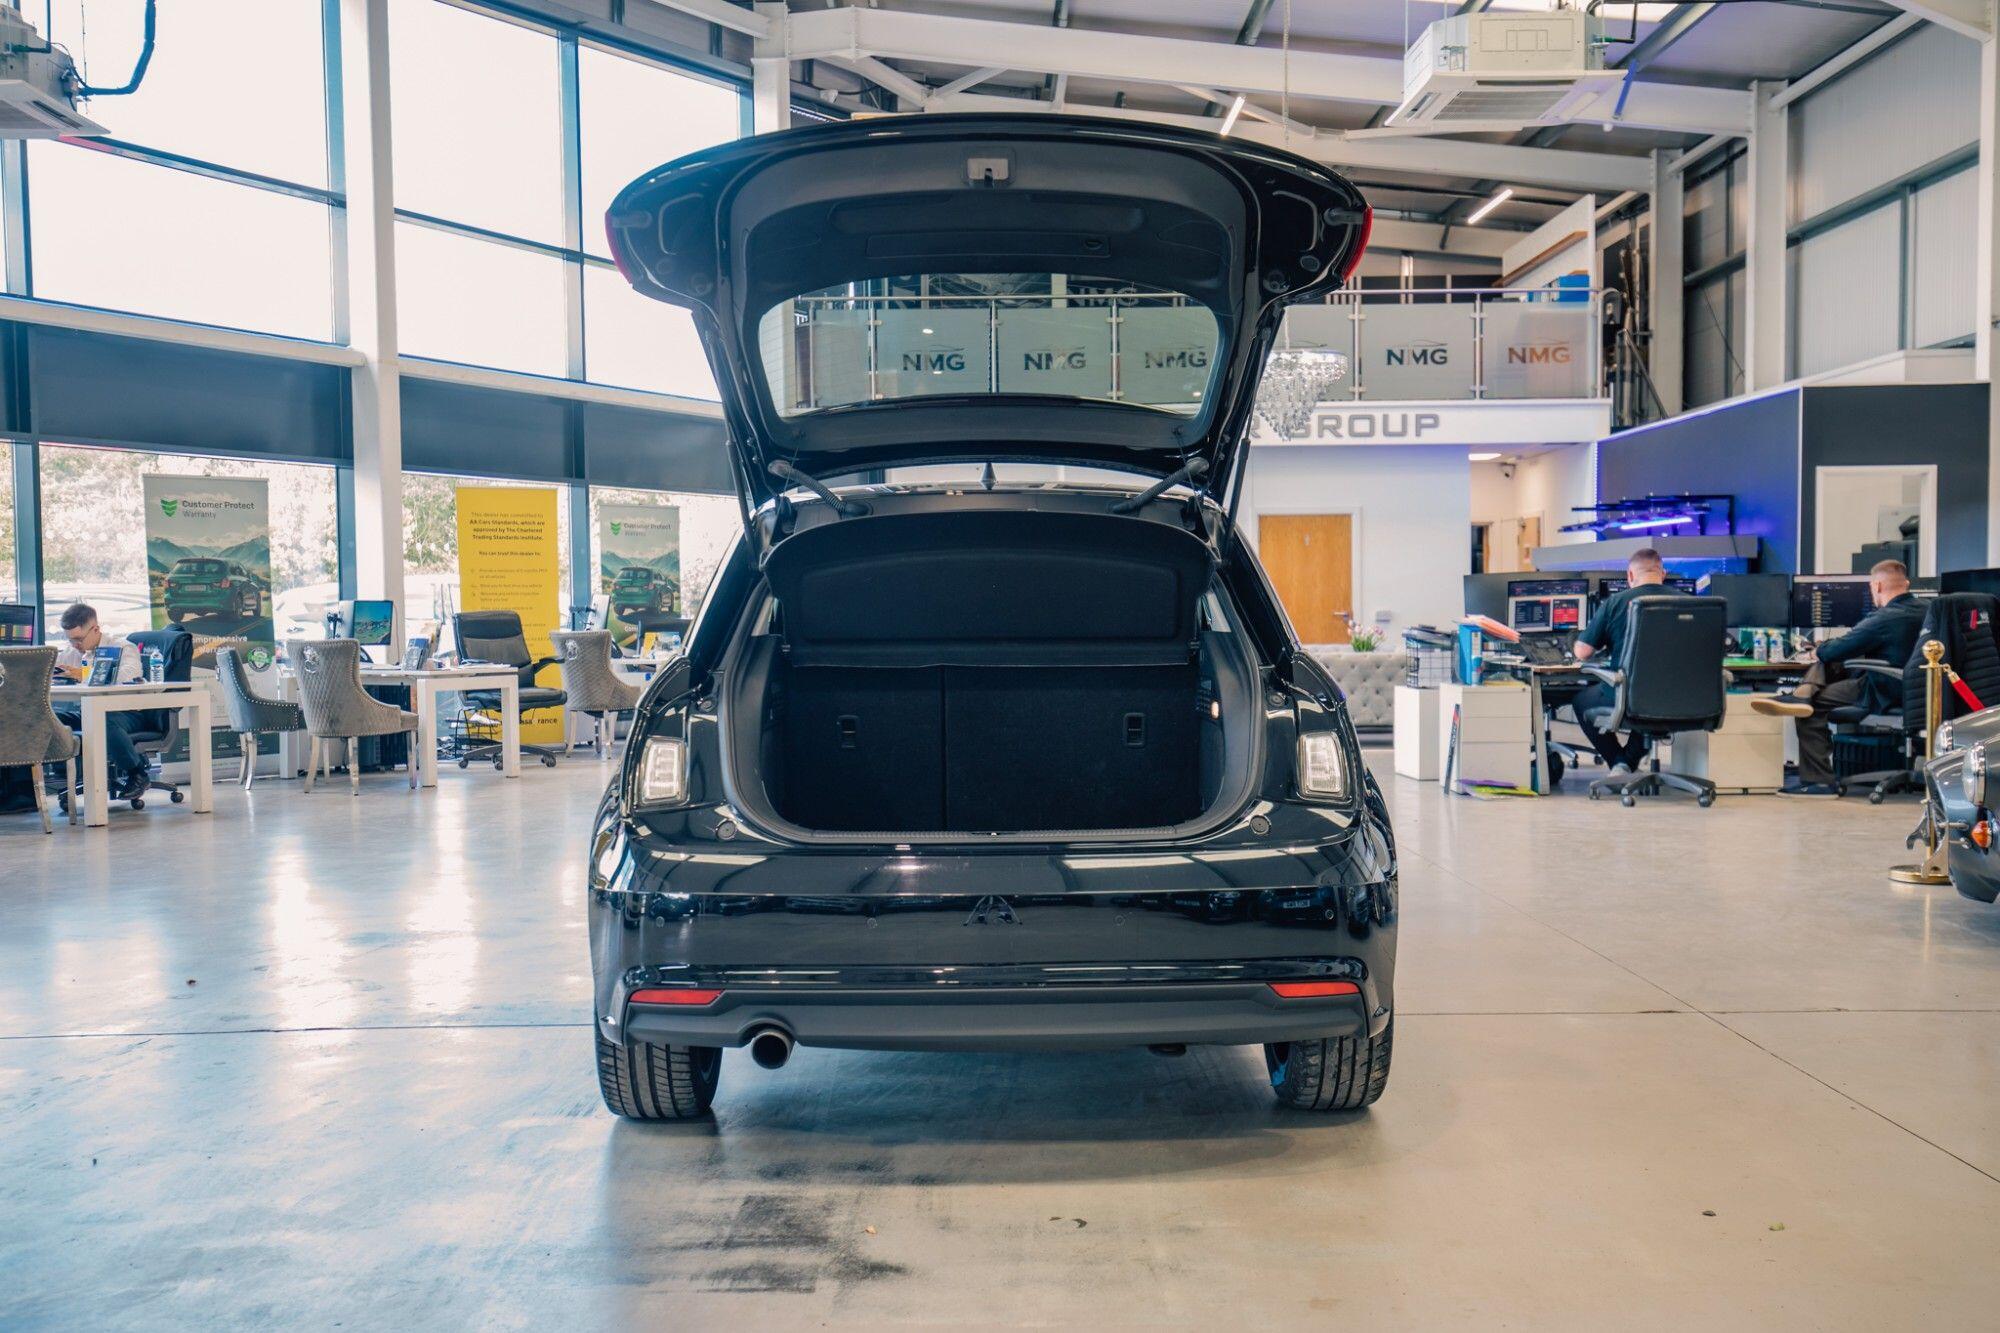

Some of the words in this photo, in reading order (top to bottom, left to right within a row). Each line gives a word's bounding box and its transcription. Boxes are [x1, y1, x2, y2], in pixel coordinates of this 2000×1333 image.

[902, 353, 966, 371] NMG
[1144, 351, 1207, 369] NMG
[1386, 348, 1448, 366] NMG
[1508, 346, 1570, 364] NMG
[182, 500, 222, 508] Customer
[224, 501, 255, 509] Protect
